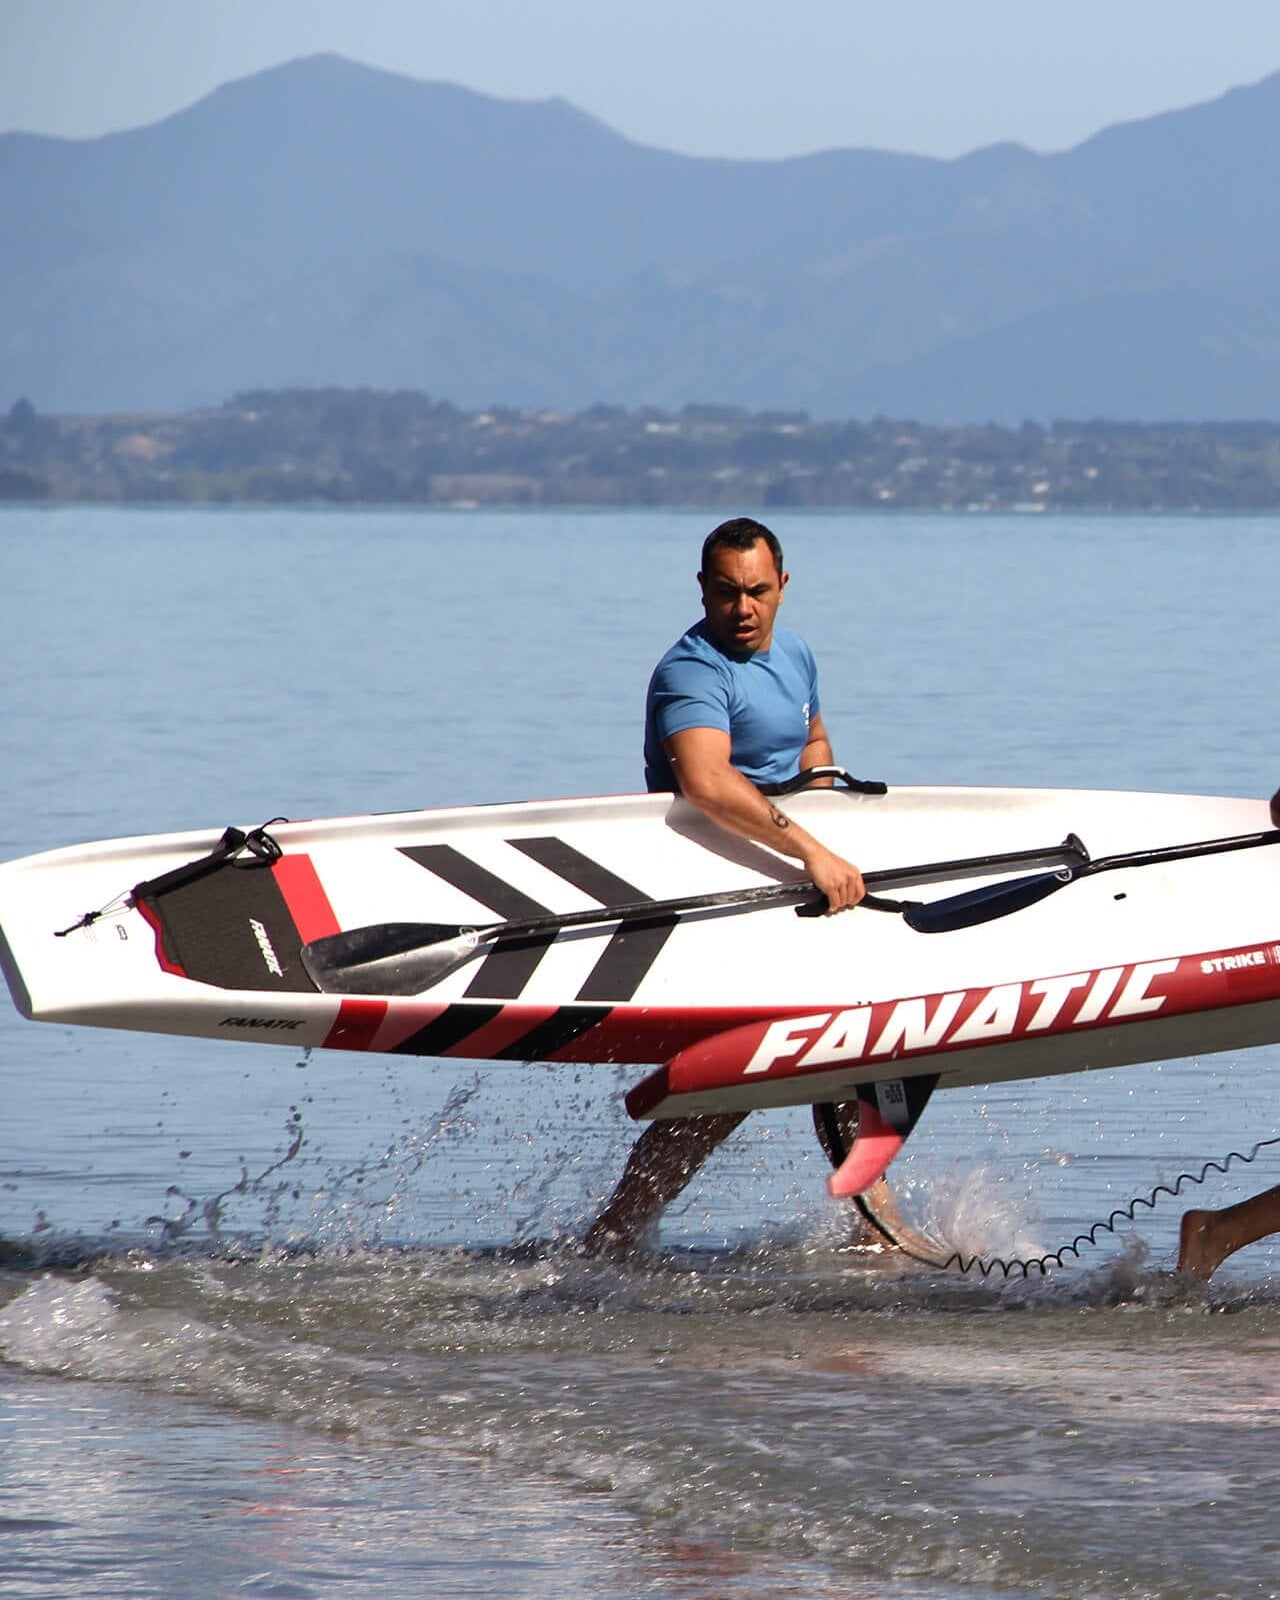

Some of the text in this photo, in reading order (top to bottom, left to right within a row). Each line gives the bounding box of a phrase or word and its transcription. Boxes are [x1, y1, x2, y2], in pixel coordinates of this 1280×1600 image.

[218, 1017, 306, 1030] FANATIC
[744, 950, 1266, 1074] FANATIC STRIKE
